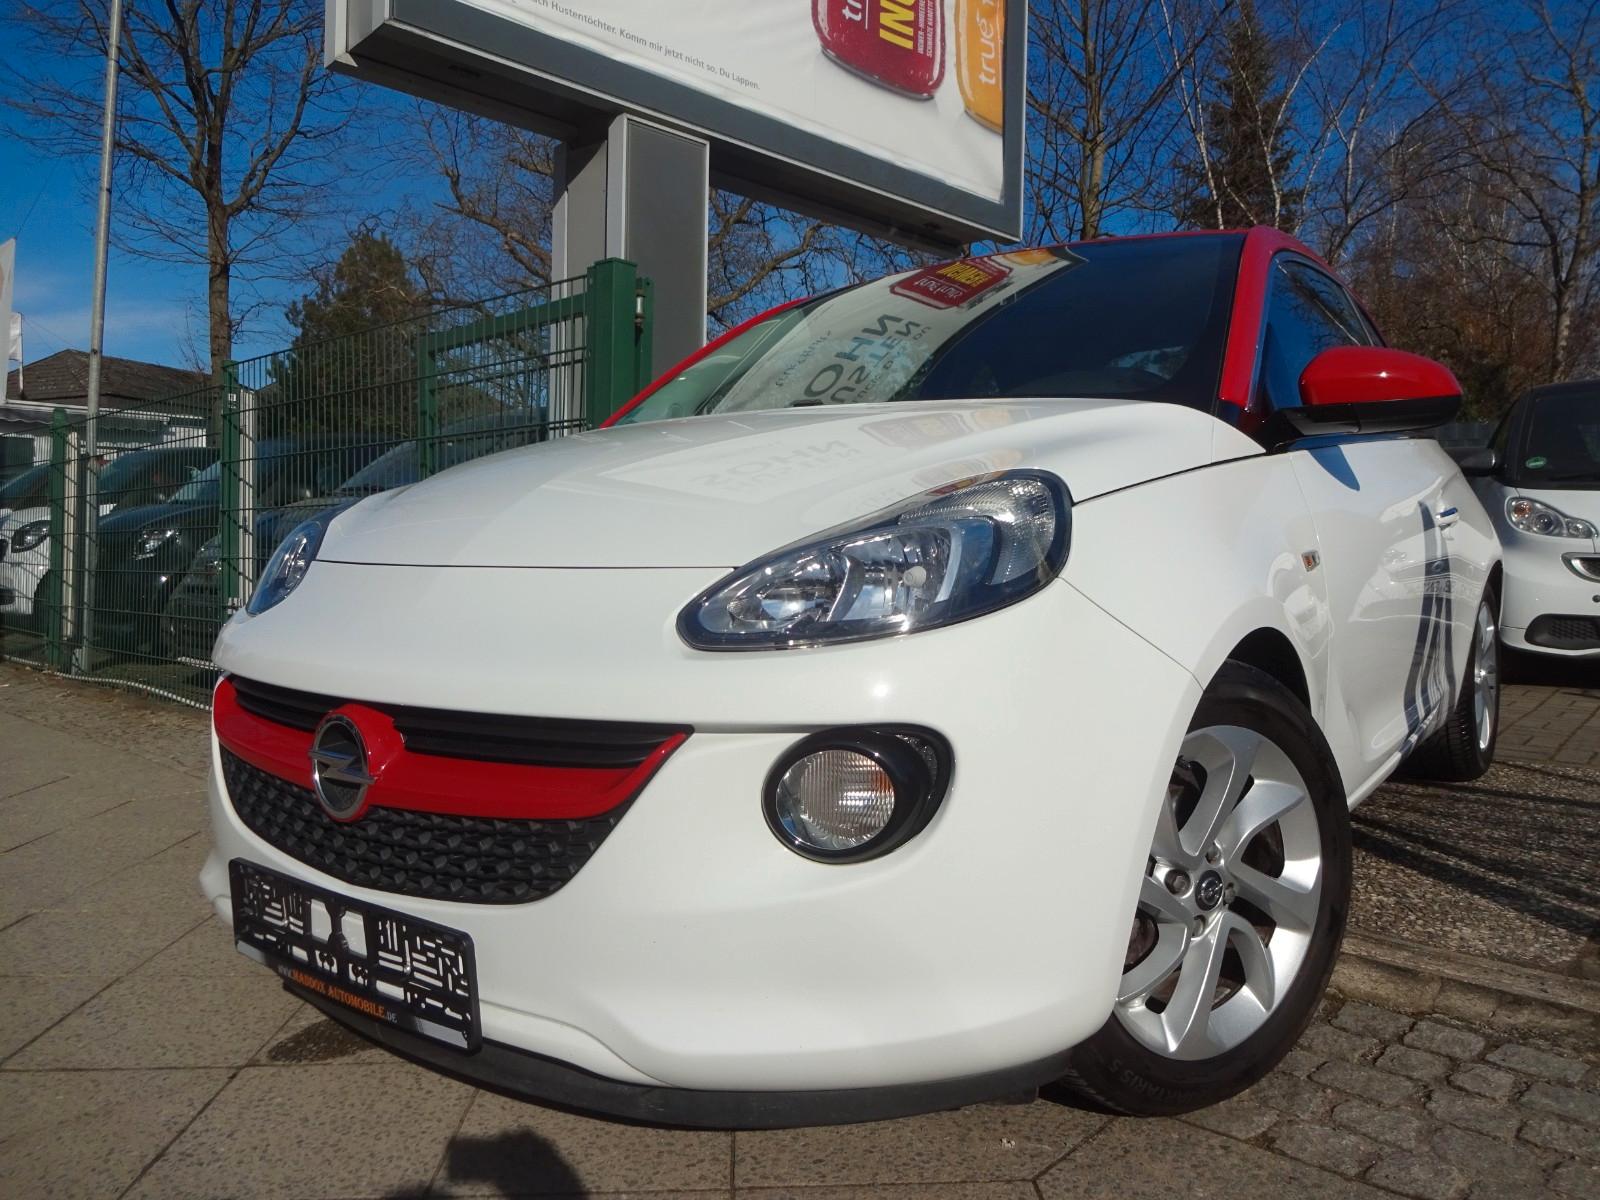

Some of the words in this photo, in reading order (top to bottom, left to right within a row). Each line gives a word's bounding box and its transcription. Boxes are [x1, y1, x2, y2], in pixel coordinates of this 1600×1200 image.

[550, 1, 617, 34] Hustentöchter.
[619, 28, 647, 46] Komm
[649, 41, 663, 52] mir
[664, 46, 683, 60] jetzt
[685, 55, 705, 69] nicht
[719, 68, 730, 78] Du
[732, 72, 761, 90] Lappen.
[976, 7, 997, 85] true
